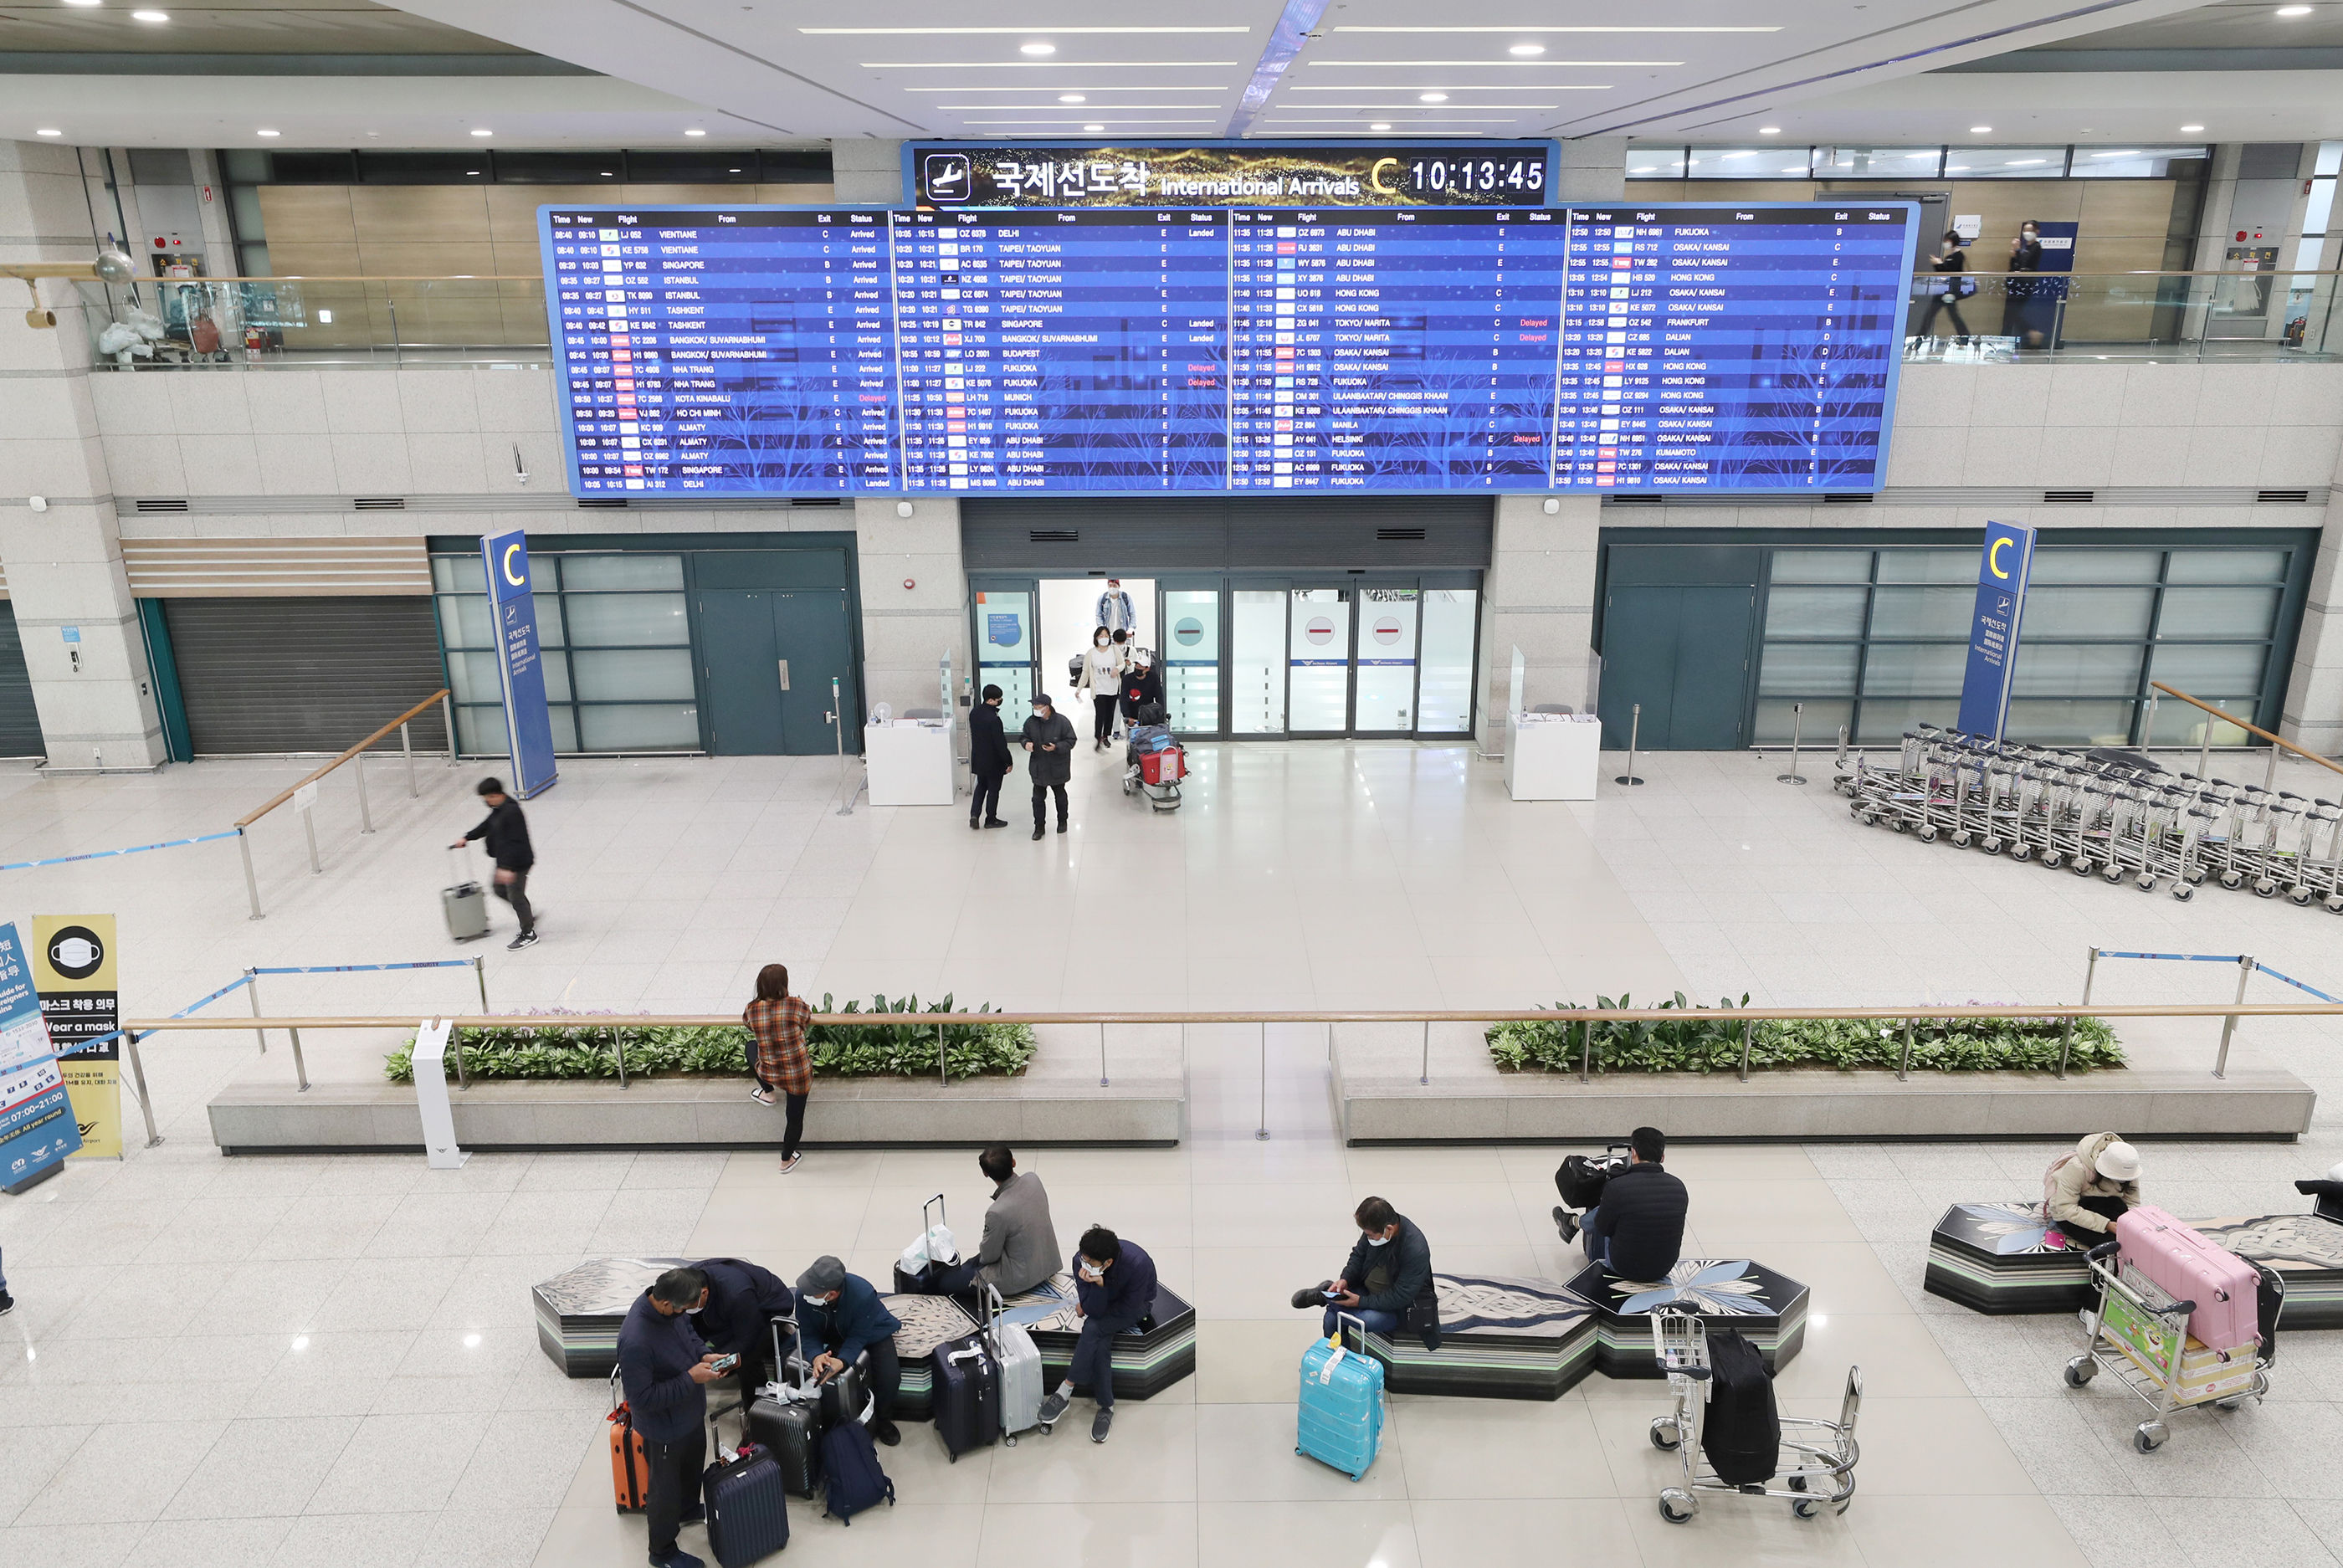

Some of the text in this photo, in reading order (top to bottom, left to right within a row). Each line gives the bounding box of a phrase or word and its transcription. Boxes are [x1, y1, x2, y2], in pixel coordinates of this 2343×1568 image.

[992, 161, 1151, 197] 국제선도착
[1161, 157, 1397, 196] International Arrivals C
[1412, 161, 1543, 191] 10:13:45
[552, 214, 873, 225] Time New Flight From Exit Status
[893, 213, 1213, 224] Time New Flight From Exit Status
[1233, 213, 1551, 223] Time New Flight From Exit Status
[1572, 212, 1890, 223] Time New Flight From Exit Status
[555, 229, 875, 239] 08:40 09:10 VIENTIANE Arrived
[895, 228, 1214, 238] 10:05 10:15 DELHI Landed
[1233, 228, 1376, 237] 11:35 11:26 ABU DHABI
[1571, 228, 1710, 237] 12:50 12:50 FUKUOKA
[998, 243, 1061, 254] TAIPEI/ TAOYUAN
[1673, 243, 1730, 252] OSAKA/ KANSAI
[662, 260, 705, 269] SINGAPORE
[664, 276, 700, 284] ISTANBUL
[1670, 273, 1715, 282] HONG KONG
[1335, 289, 1380, 298] HONG KONG
[666, 306, 705, 315] TASHKENT
[1001, 319, 1214, 329] SINGAPORE Landed
[1334, 318, 1548, 328] TOKYO/ NARITA Delayed
[1666, 318, 1710, 326] FRANKFURT
[669, 336, 881, 345] BANGKOK/ SUVARNABHUMI Arrived
[1002, 334, 1214, 344] BANGKOK/ SUVARNABHUMI Landed
[1665, 333, 1692, 341] DALIAN
[1002, 349, 1040, 358] BUDAPEST
[1334, 347, 1390, 357] OSAKA/ KANSAI
[672, 365, 715, 374] NHA TRANG
[1002, 363, 1216, 373] FUKUOKA Delayed
[1663, 362, 1707, 371] HONG KONG
[674, 393, 887, 403] KOTA KINABALU Delayed
[1003, 393, 1033, 402] MUNICH
[1332, 392, 1448, 401] ULAANBAATAR/ CHINGGIS KHAAN
[676, 409, 688, 418] HO
[689, 409, 702, 418] CHI
[678, 423, 706, 432] ALMATY
[1332, 421, 1359, 429] MANILA
[1005, 436, 1043, 444] ABU DHABI
[1331, 435, 1541, 444] HELSINKI Delayed
[1655, 448, 1696, 457] KUMAMOTO
[683, 480, 705, 489] DELHI
[1330, 477, 1365, 485] FUKUOKA
[1653, 475, 1708, 484] OSAKA/ KANSAI
[1989, 537, 2013, 580] C
[504, 543, 526, 587] C
[1981, 615, 2007, 633] 국제선도착
[508, 624, 531, 640] 국제선도착
[1974, 643, 2002, 660] International
[512, 653, 536, 669] International
[1984, 655, 2001, 667] Arrivals
[513, 664, 527, 676] Arrivals
[15, 983, 26, 992] for
[39, 998, 115, 1012] 마스크 착용 의무
[74, 1023, 82, 1032] a
[85, 1021, 115, 1032] mask
[11, 1092, 63, 1122] 07:00~21:00
[30, 1118, 44, 1129] year
[44, 1109, 62, 1121] round
